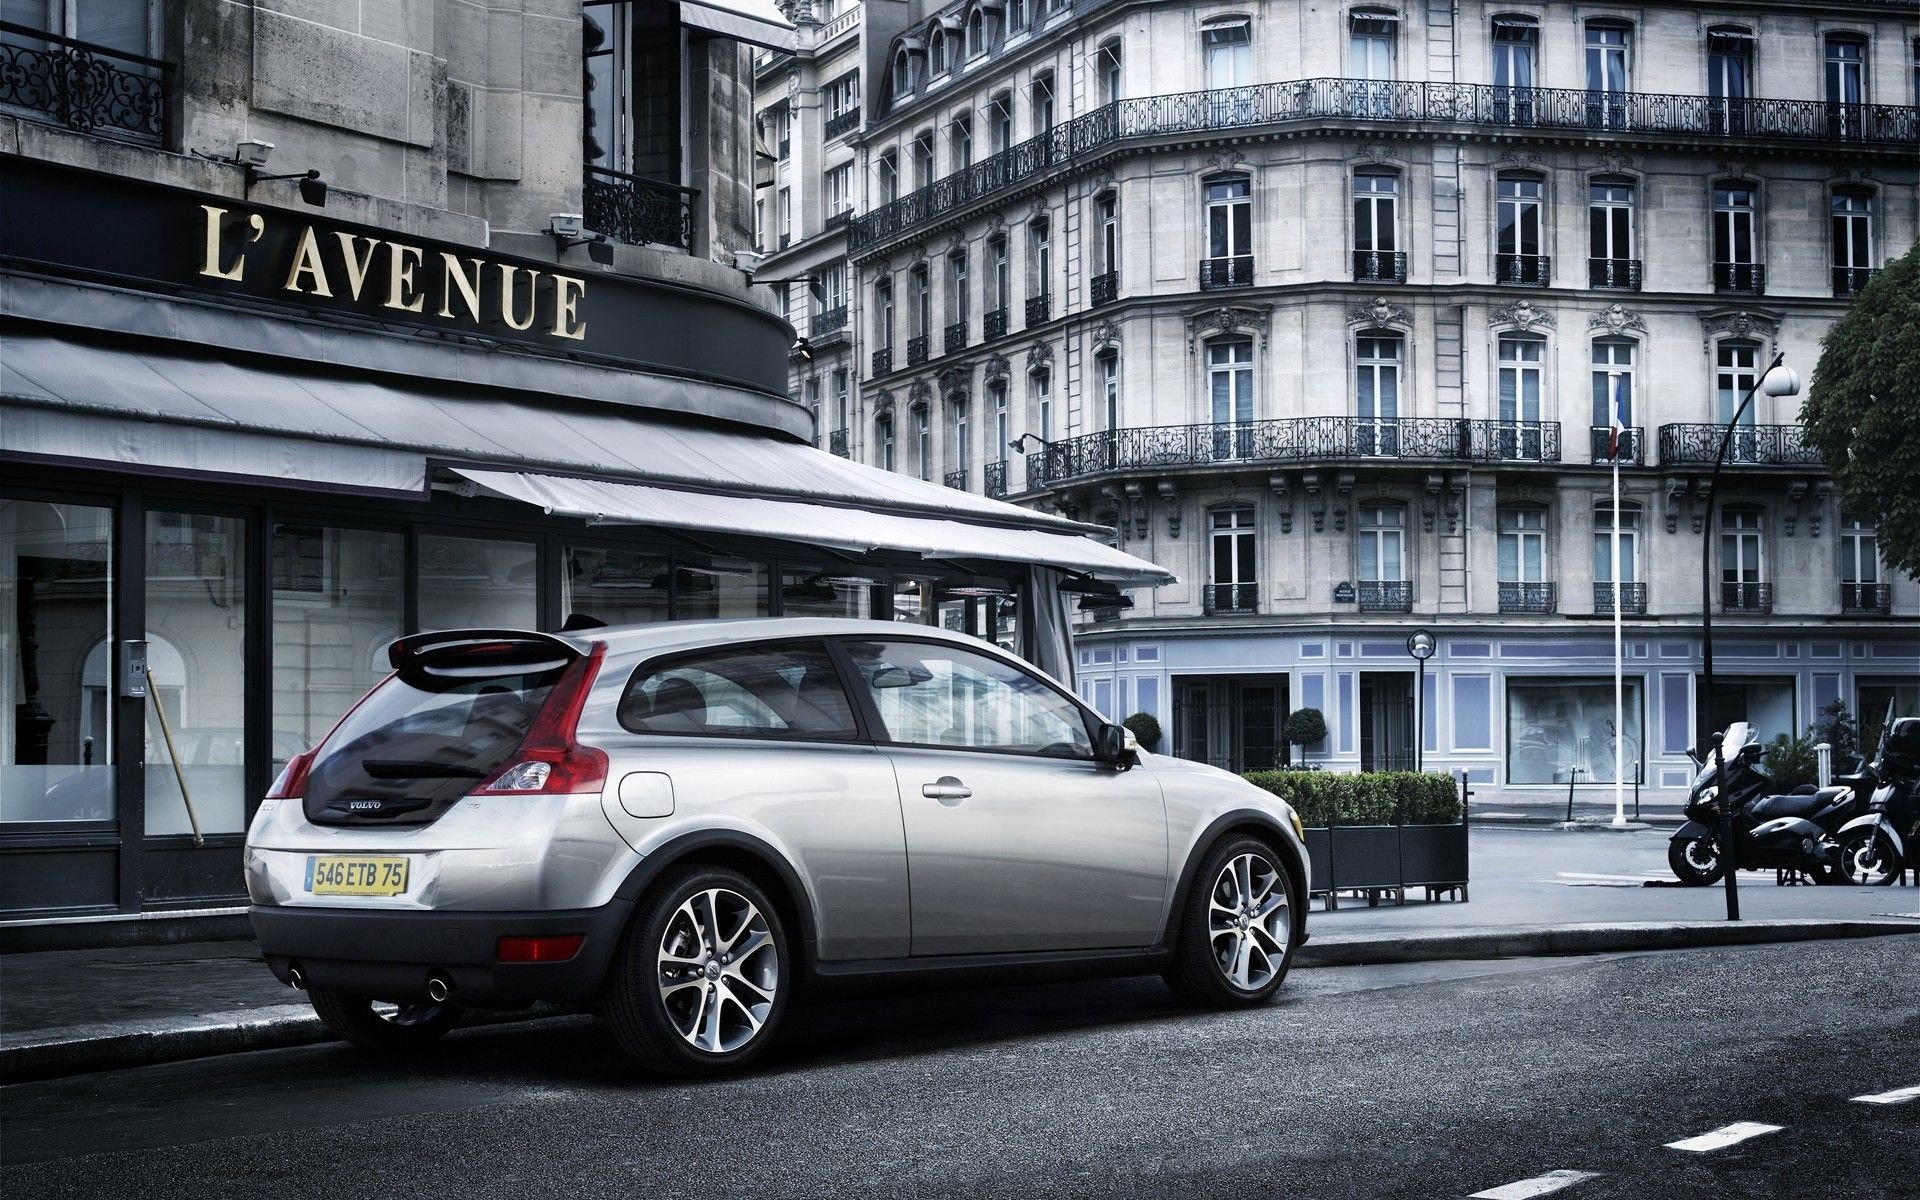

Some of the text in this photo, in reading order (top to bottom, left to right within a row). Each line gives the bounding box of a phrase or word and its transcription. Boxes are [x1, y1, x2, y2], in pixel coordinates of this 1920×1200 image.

[200, 204, 587, 341] L'AVENUE
[350, 801, 381, 809] VOLVO
[316, 862, 402, 886] 546 ETB 75
